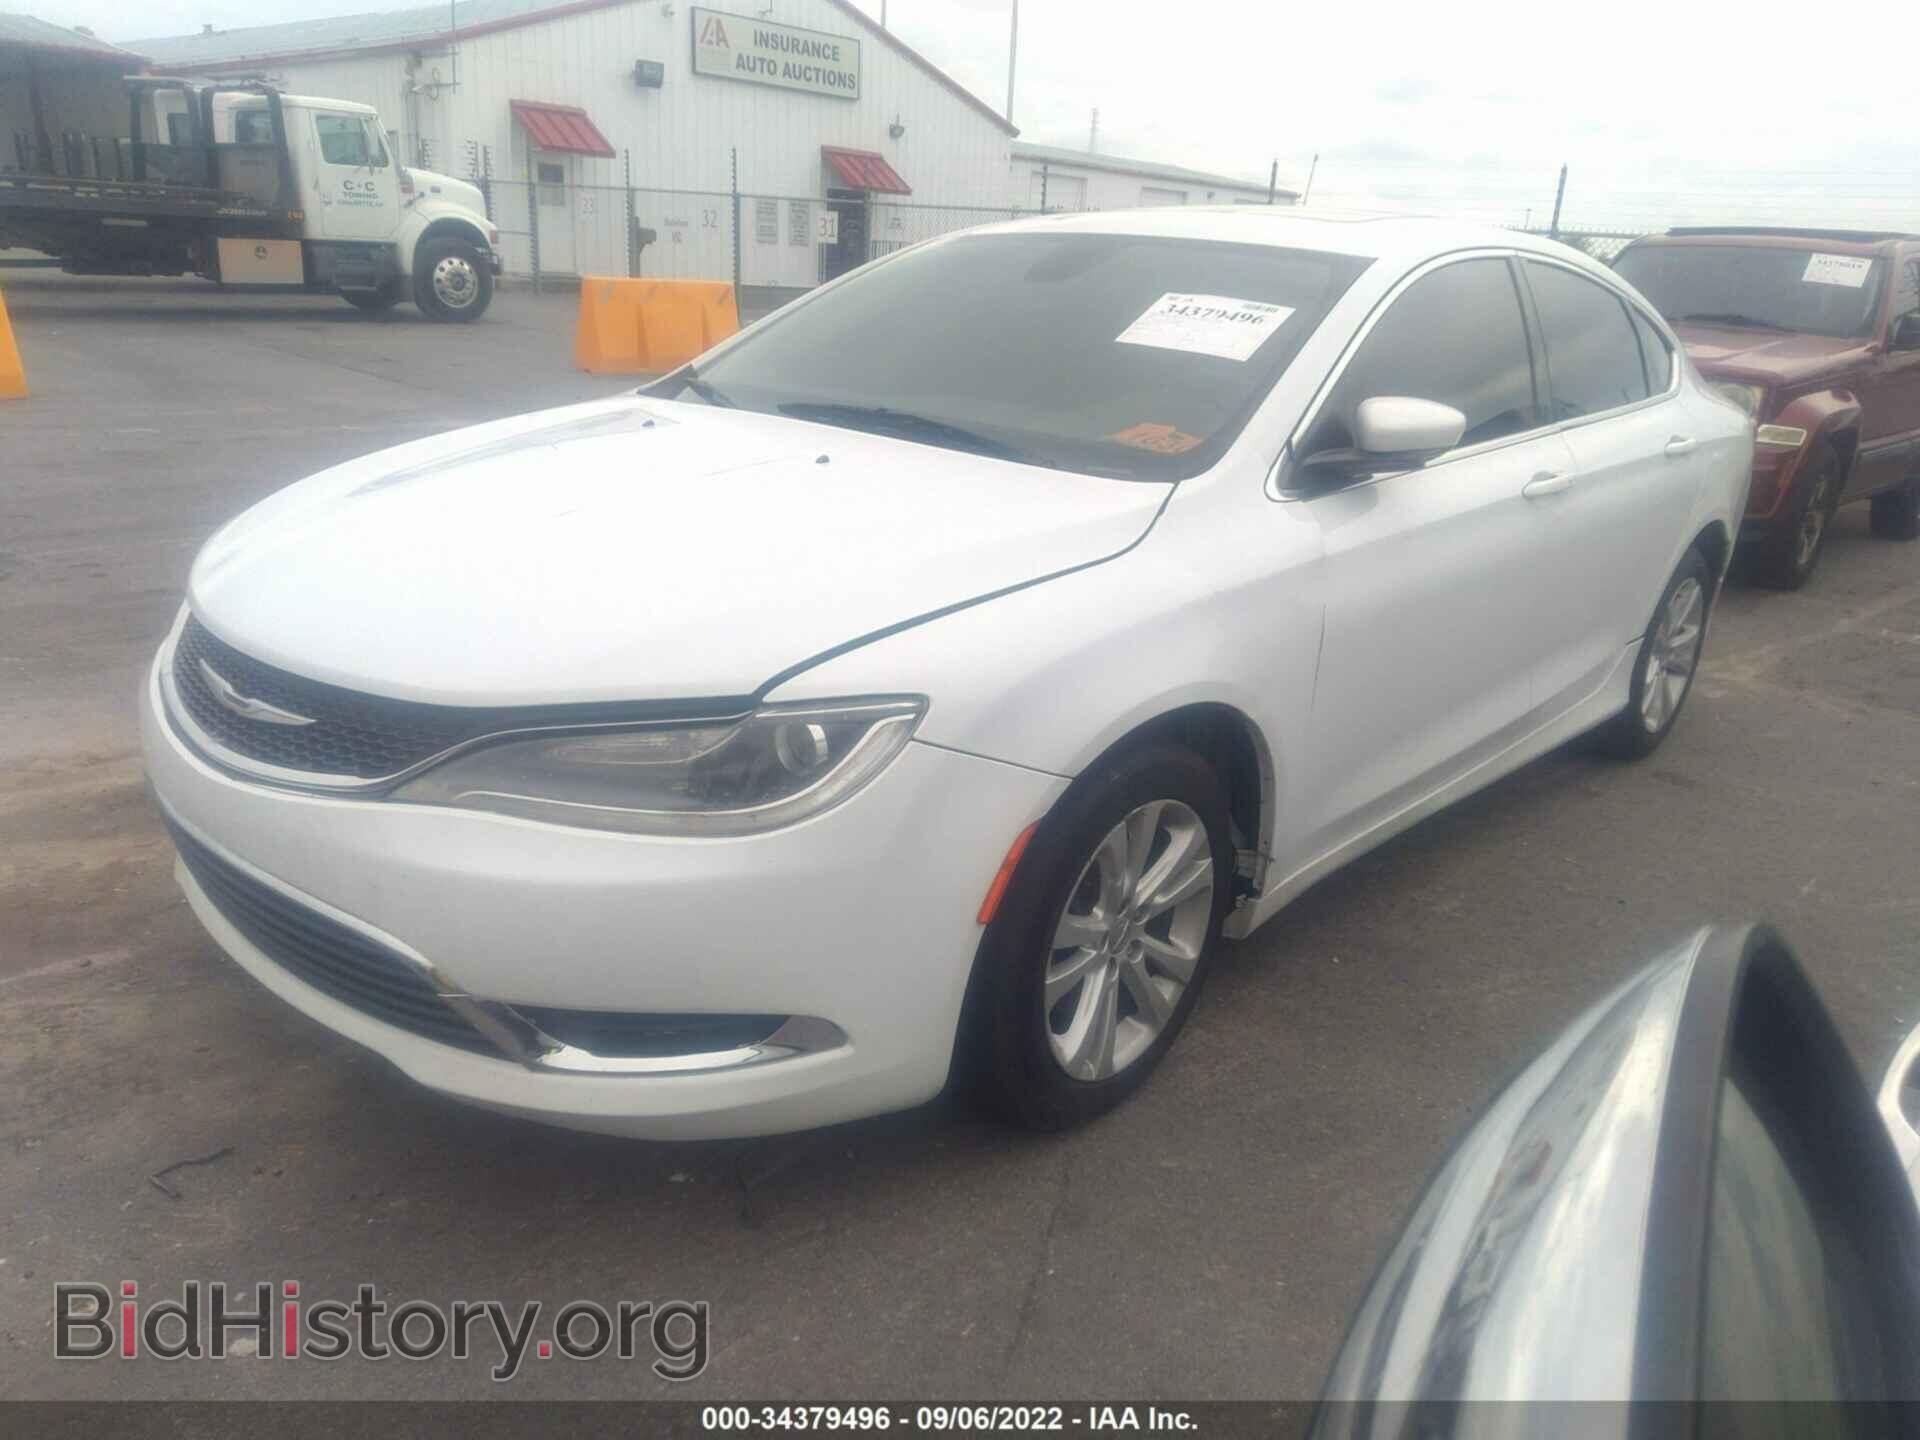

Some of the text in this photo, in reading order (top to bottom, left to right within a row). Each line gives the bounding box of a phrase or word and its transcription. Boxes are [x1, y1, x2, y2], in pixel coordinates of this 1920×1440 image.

[753, 28, 840, 62] INSURANCE
[736, 53, 856, 90] AUTO AUCTIONS
[702, 209, 719, 228] 32
[818, 216, 836, 238] 31
[1160, 303, 1264, 325] 34379496
